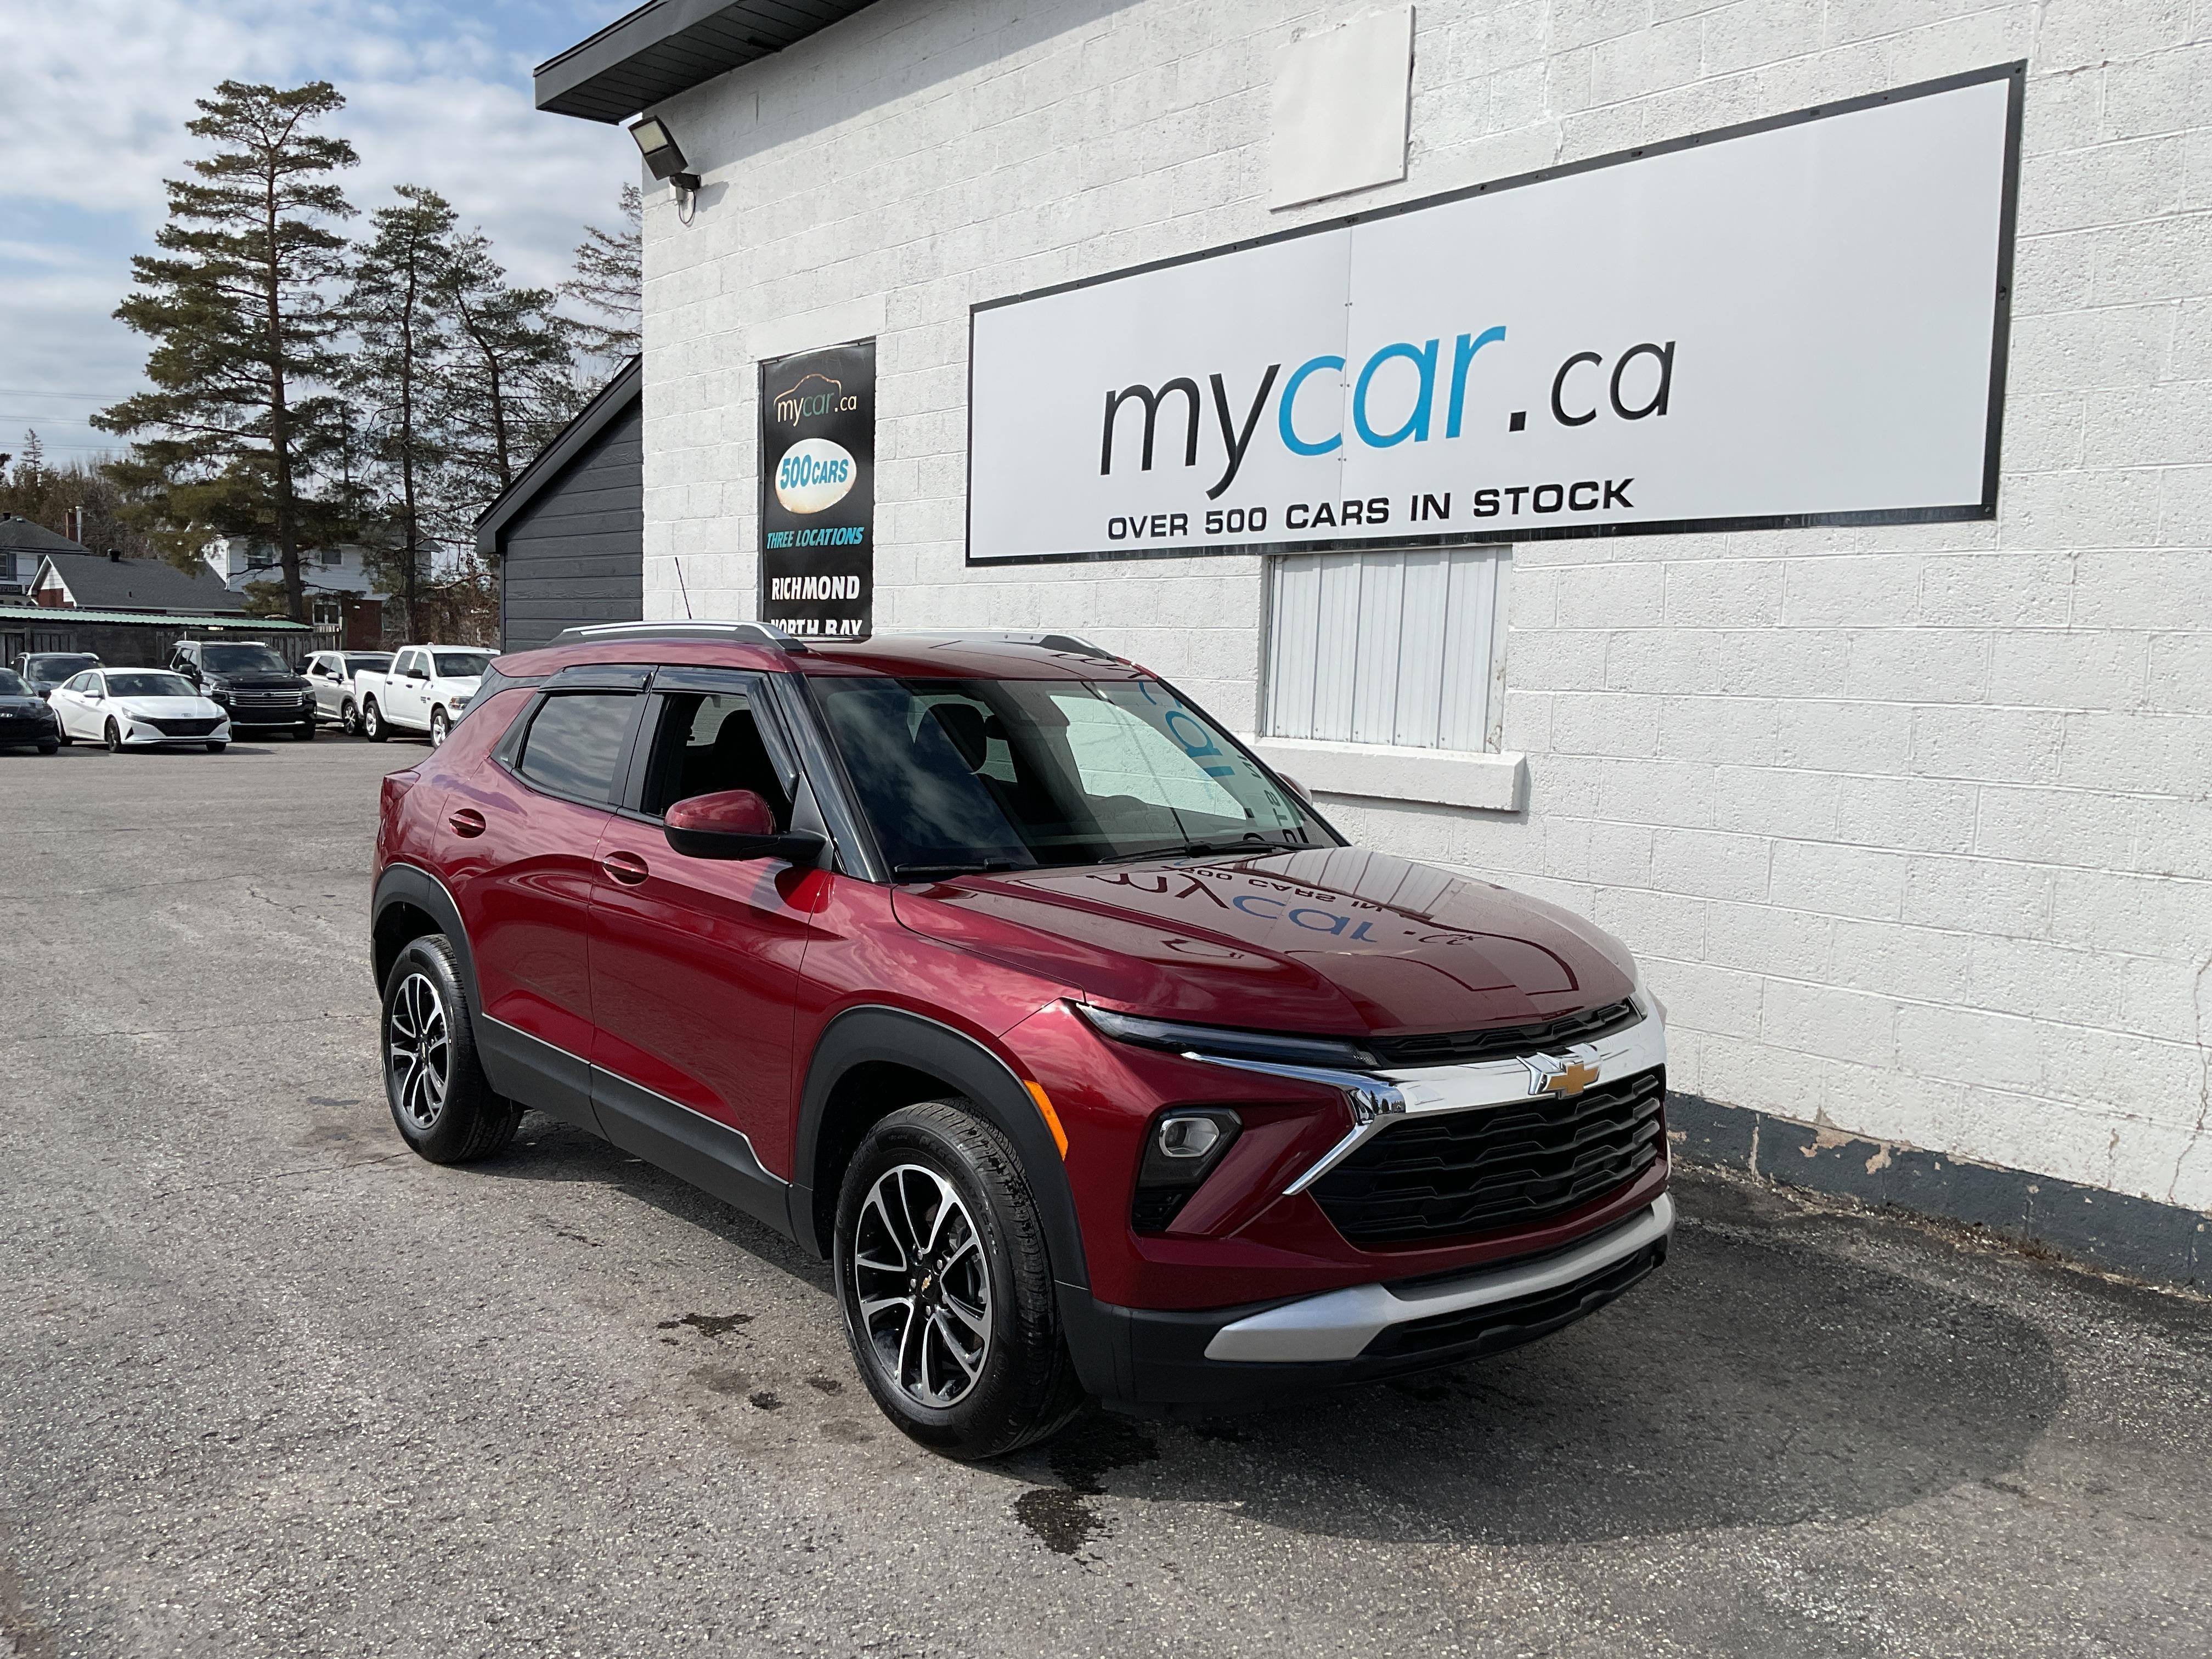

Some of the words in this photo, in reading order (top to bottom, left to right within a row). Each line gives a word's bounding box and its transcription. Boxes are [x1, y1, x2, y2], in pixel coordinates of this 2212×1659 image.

[777, 392, 857, 427] mycar.ca
[1099, 325, 1676, 500] mycar.ca
[1107, 512, 1188, 539] OVER
[1205, 506, 1267, 534] 500
[1285, 496, 1390, 529] CARS
[1409, 492, 1451, 522] IN
[1472, 477, 1635, 518] STOCK
[766, 531, 795, 549] THREE
[795, 527, 865, 548] LOCATIONS
[771, 575, 860, 600] RICHMOND
